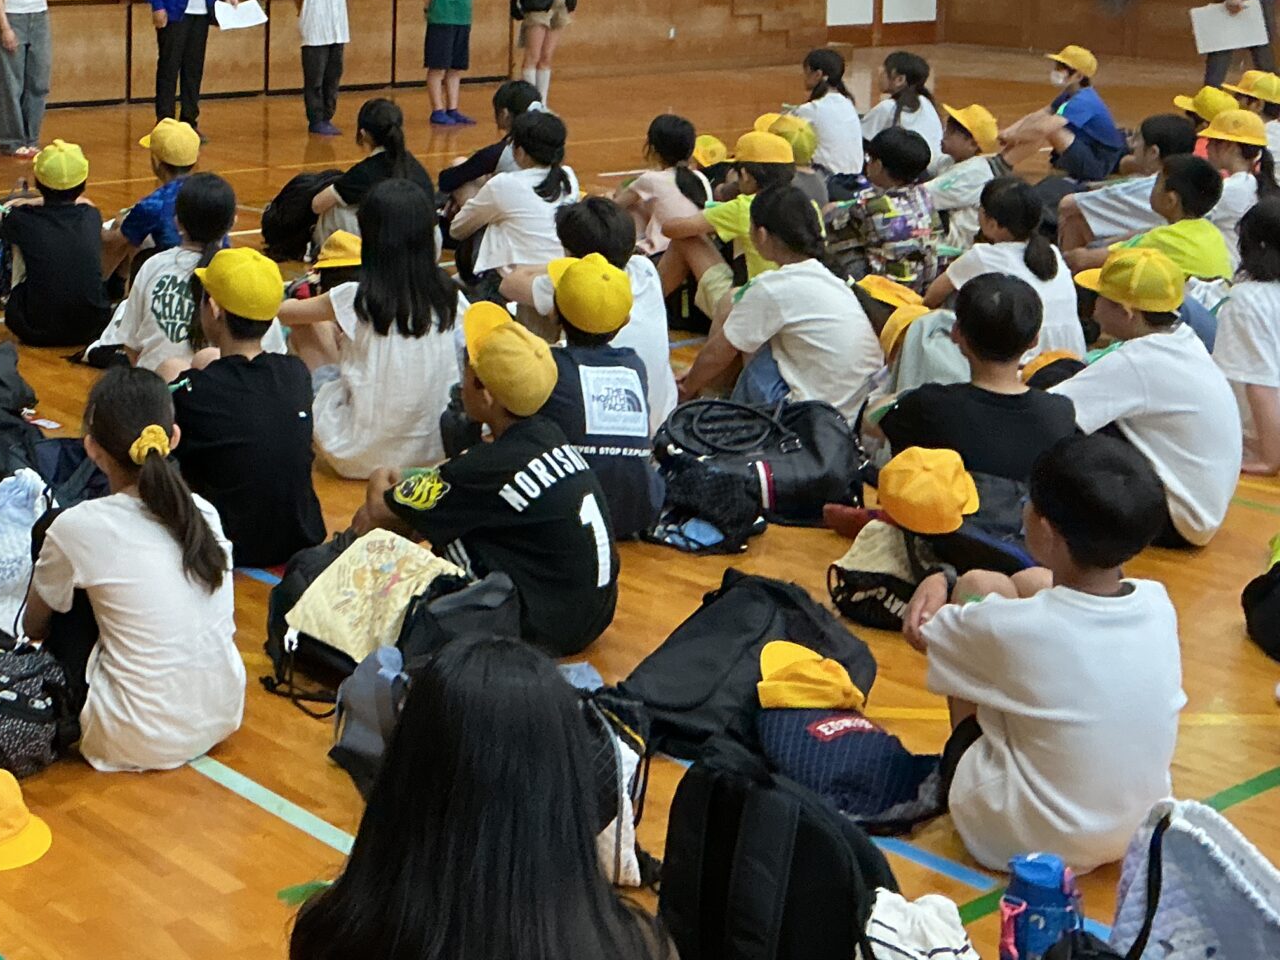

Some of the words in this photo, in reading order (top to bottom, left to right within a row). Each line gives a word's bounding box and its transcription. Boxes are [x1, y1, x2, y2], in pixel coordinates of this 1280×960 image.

[603, 386, 624, 395] THE
[591, 394, 626, 403] NORTH
[602, 402, 626, 412] FACE
[599, 446, 622, 456] STOP
[579, 493, 612, 588] 1
